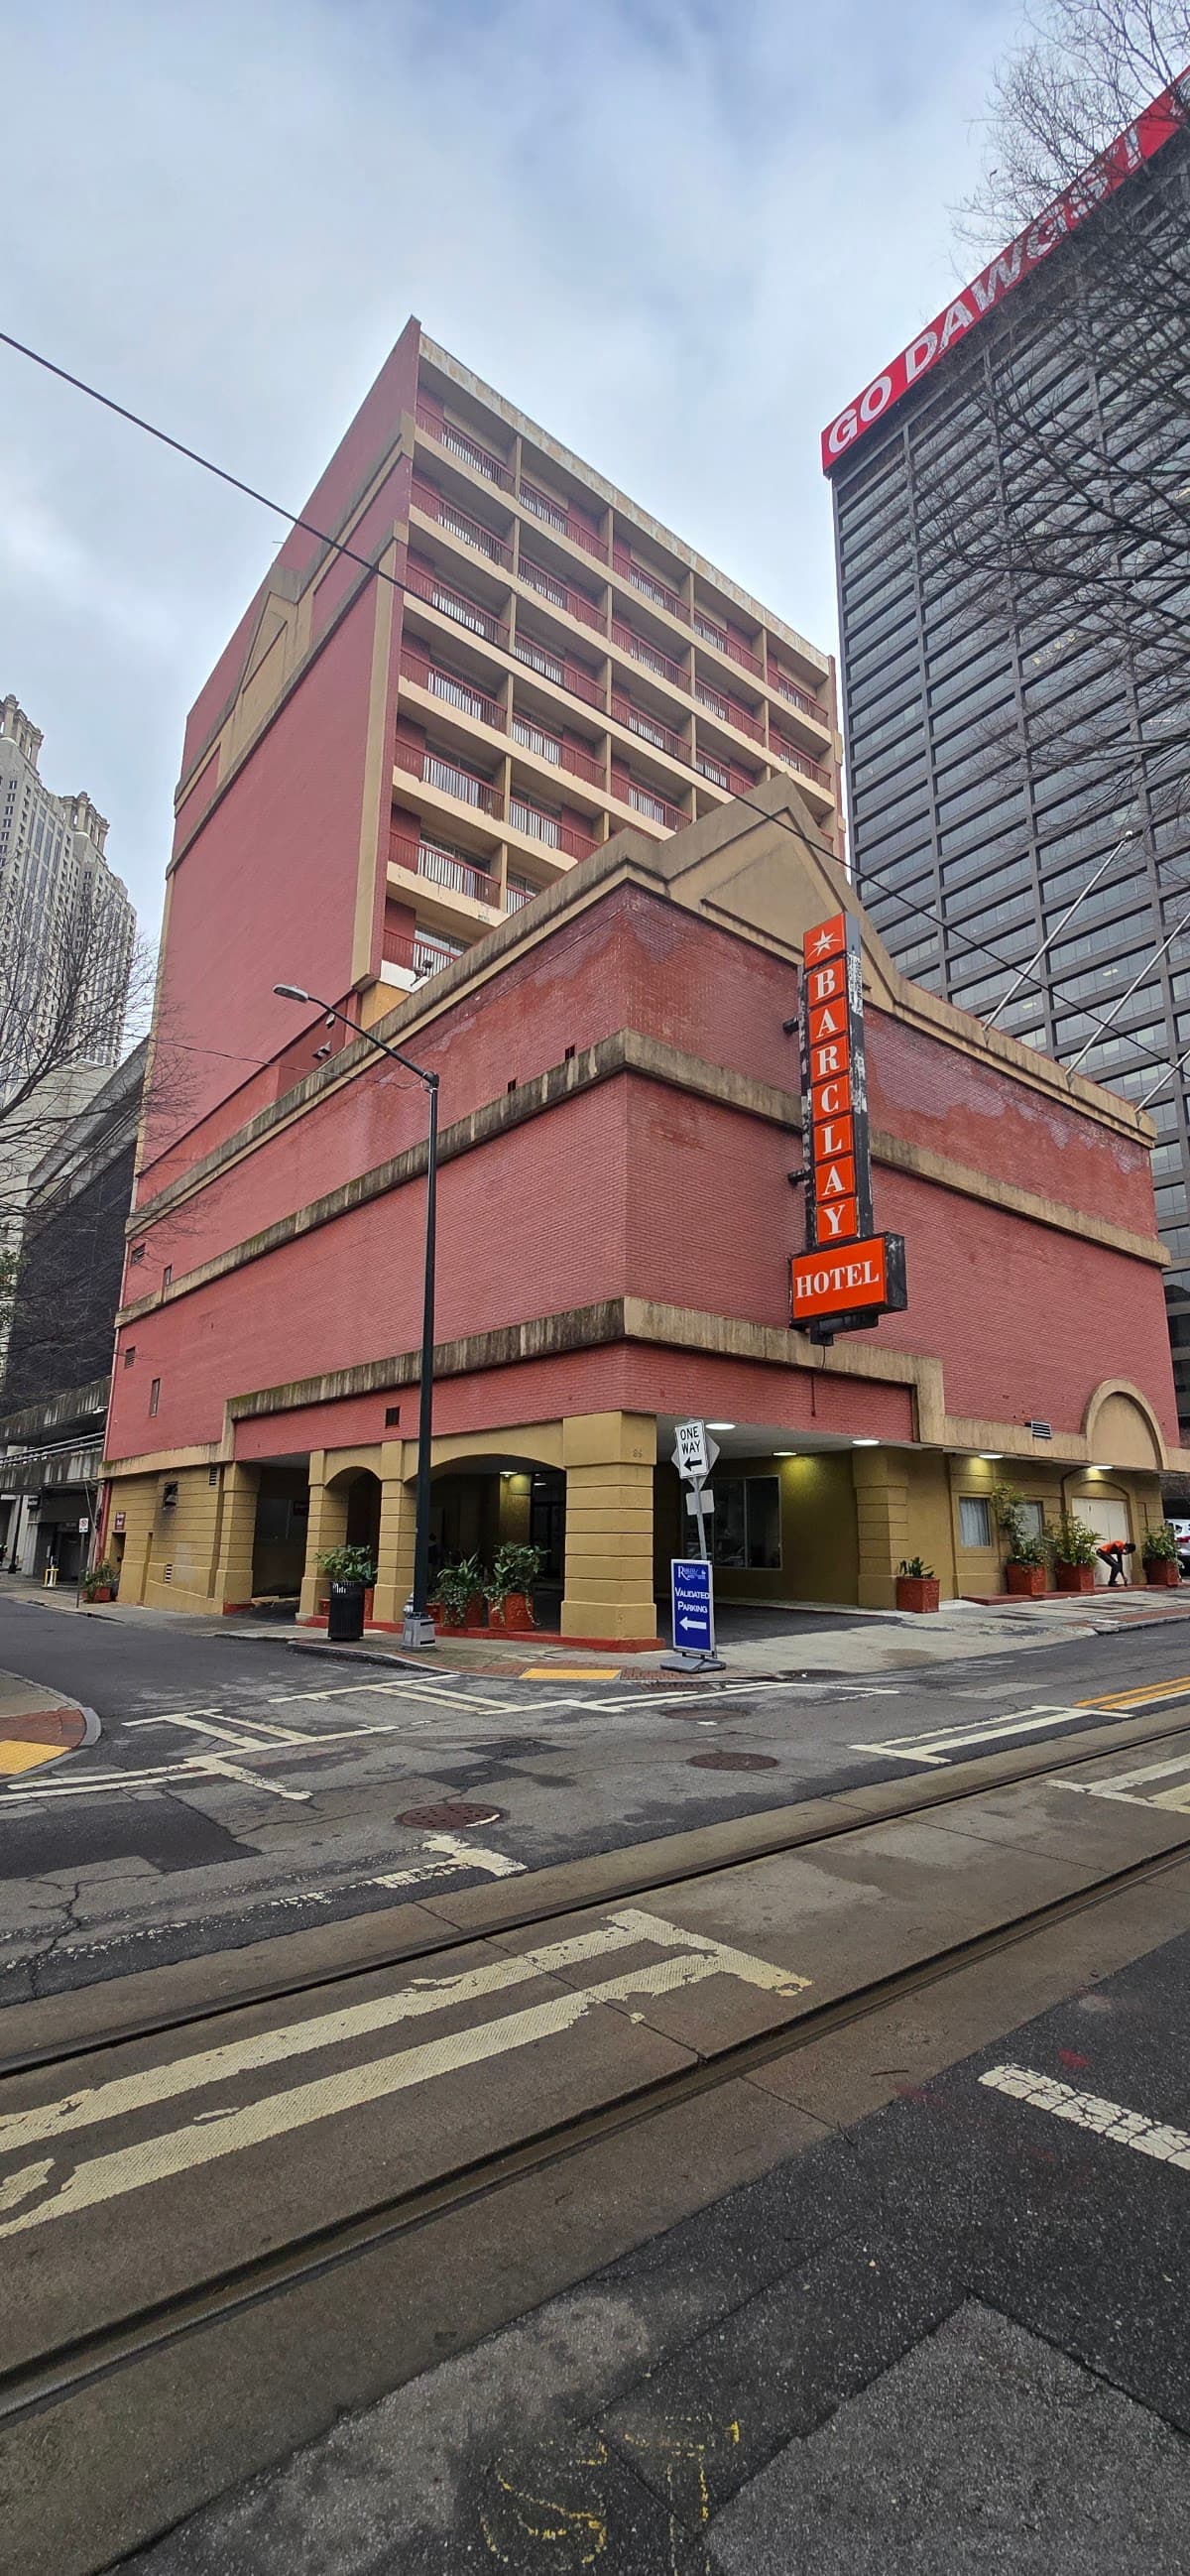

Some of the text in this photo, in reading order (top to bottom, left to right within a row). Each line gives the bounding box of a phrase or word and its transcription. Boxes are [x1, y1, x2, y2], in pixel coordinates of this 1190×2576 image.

[828, 375, 892, 453] GO
[813, 967, 846, 1237] BARCLAY
[795, 1260, 880, 1299] HOTEL
[679, 1425, 699, 1440] ONE
[681, 1439, 700, 1455] WAY
